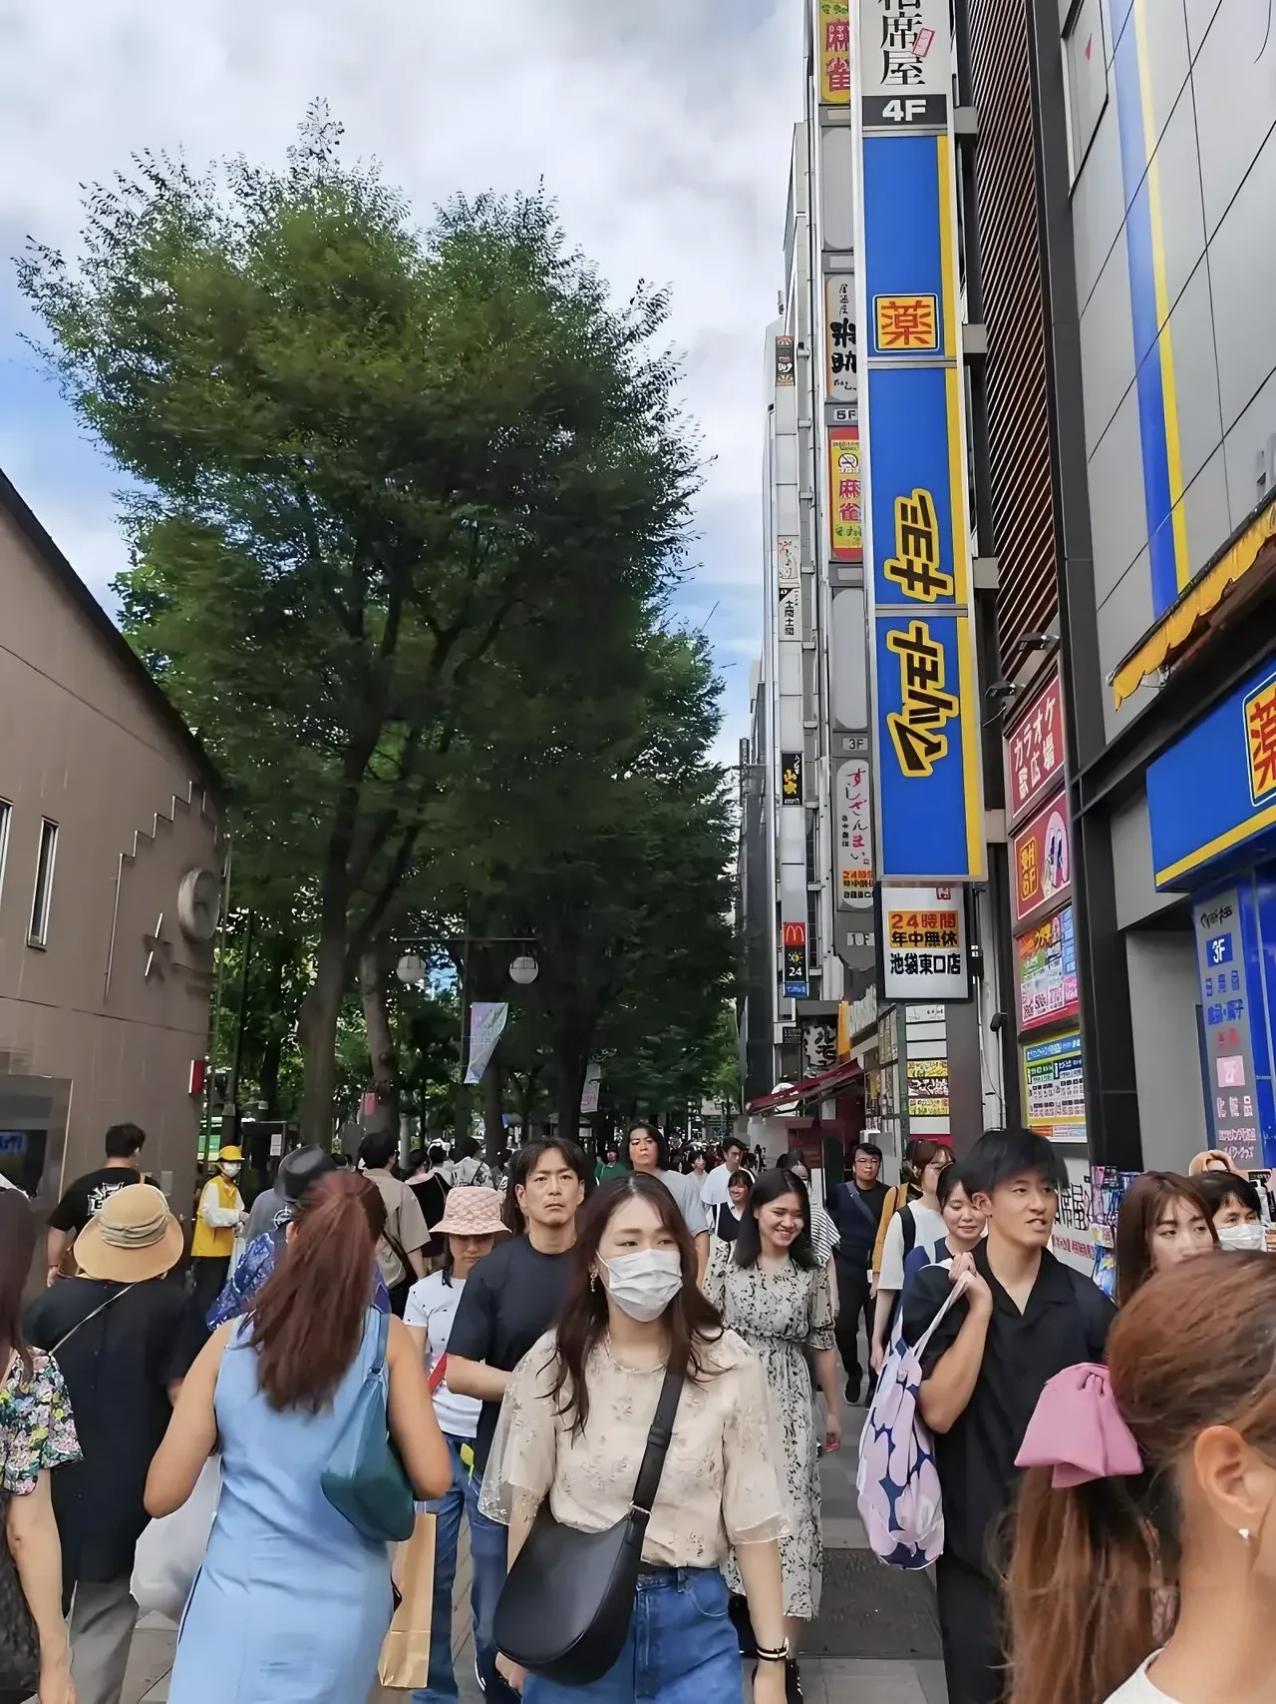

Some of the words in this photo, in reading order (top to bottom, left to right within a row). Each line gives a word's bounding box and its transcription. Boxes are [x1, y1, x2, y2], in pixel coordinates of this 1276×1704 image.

[879, 0, 926, 85] 席屋
[882, 99, 926, 121] 4F
[881, 300, 932, 346] 薬
[849, 738, 864, 750] 3F
[1014, 697, 1056, 772] カラオケ
[845, 767, 868, 860] すしざんまい
[891, 913, 956, 929] 24時間
[892, 931, 957, 947] 年中無休
[1212, 938, 1226, 963] 3F
[789, 966, 802, 976] 24
[890, 952, 960, 975] 池袋東口店
